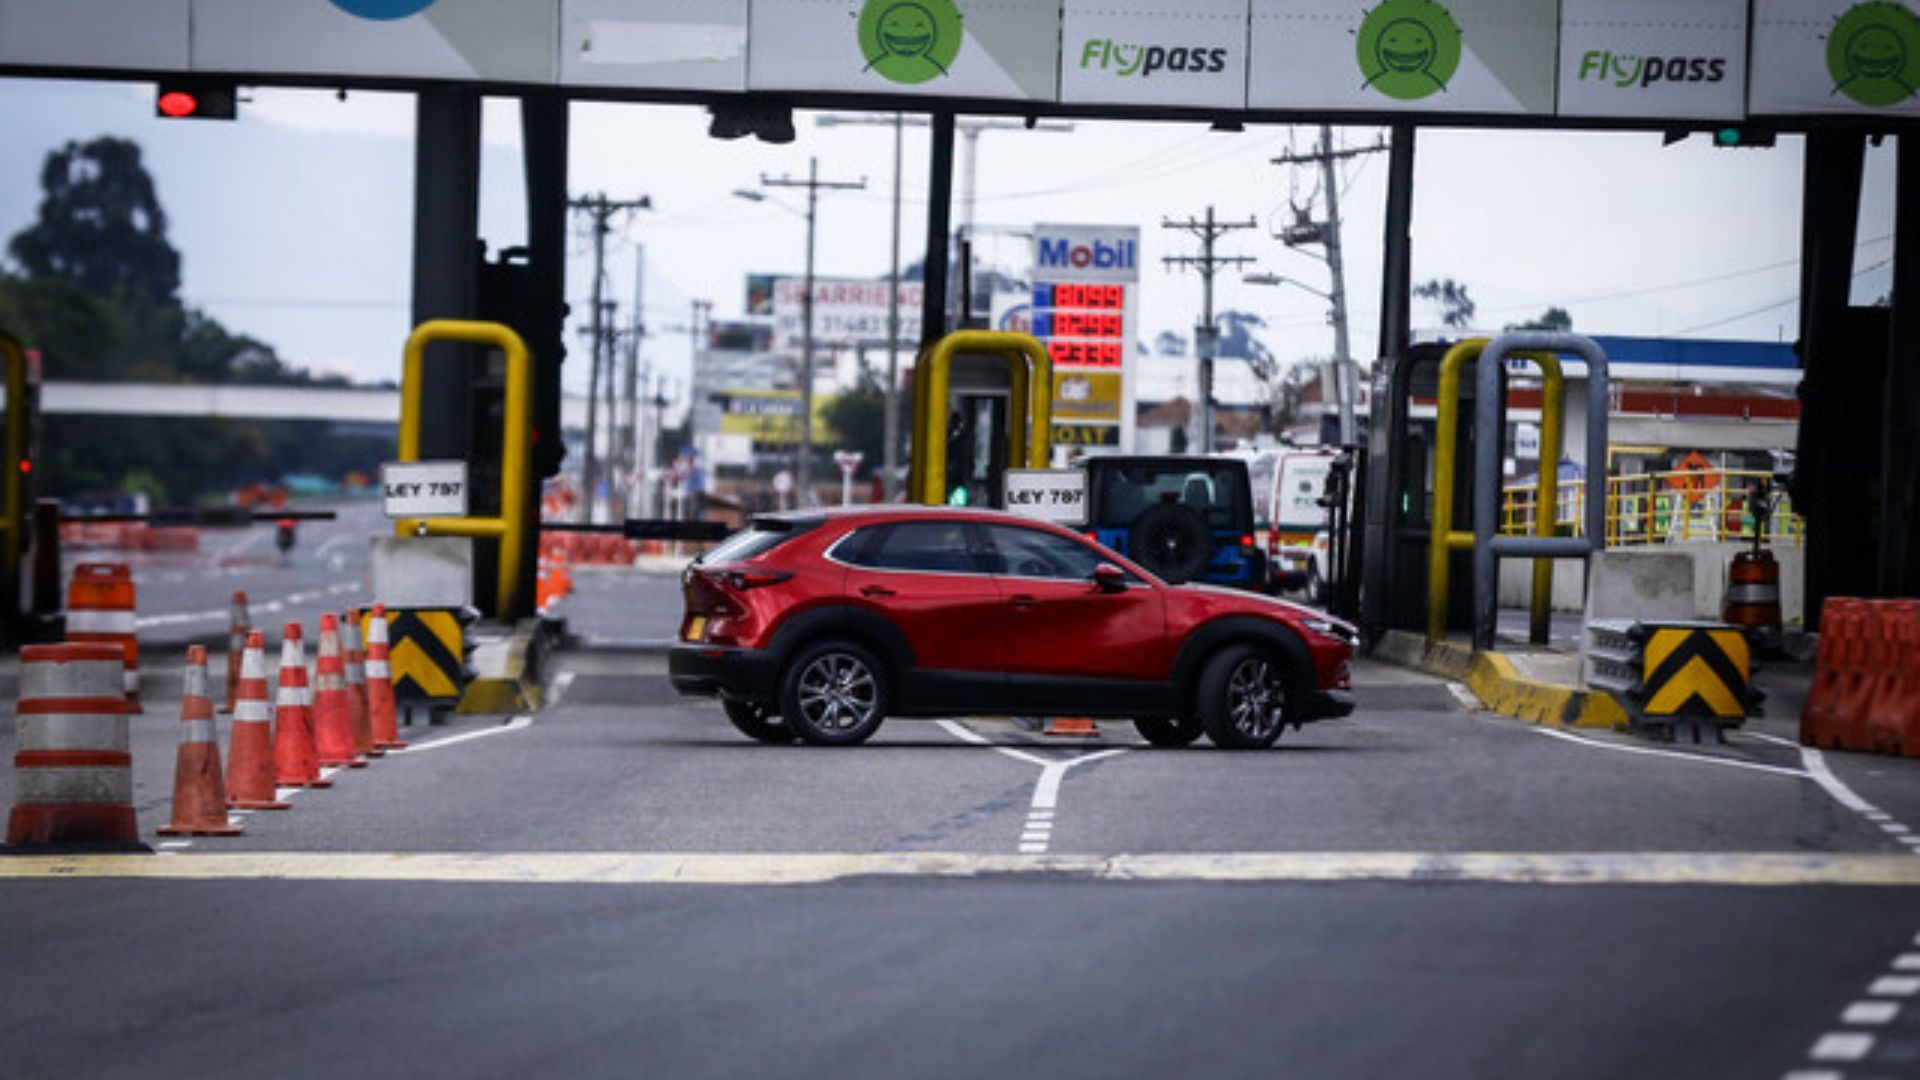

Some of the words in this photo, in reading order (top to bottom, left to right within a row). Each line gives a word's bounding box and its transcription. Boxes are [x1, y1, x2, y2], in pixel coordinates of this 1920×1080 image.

[1079, 38, 1228, 76] Flypass
[1577, 49, 1727, 88] Flypass
[1038, 237, 1136, 269] Mobil
[385, 483, 422, 498] LEY
[1007, 488, 1045, 504] LEY
